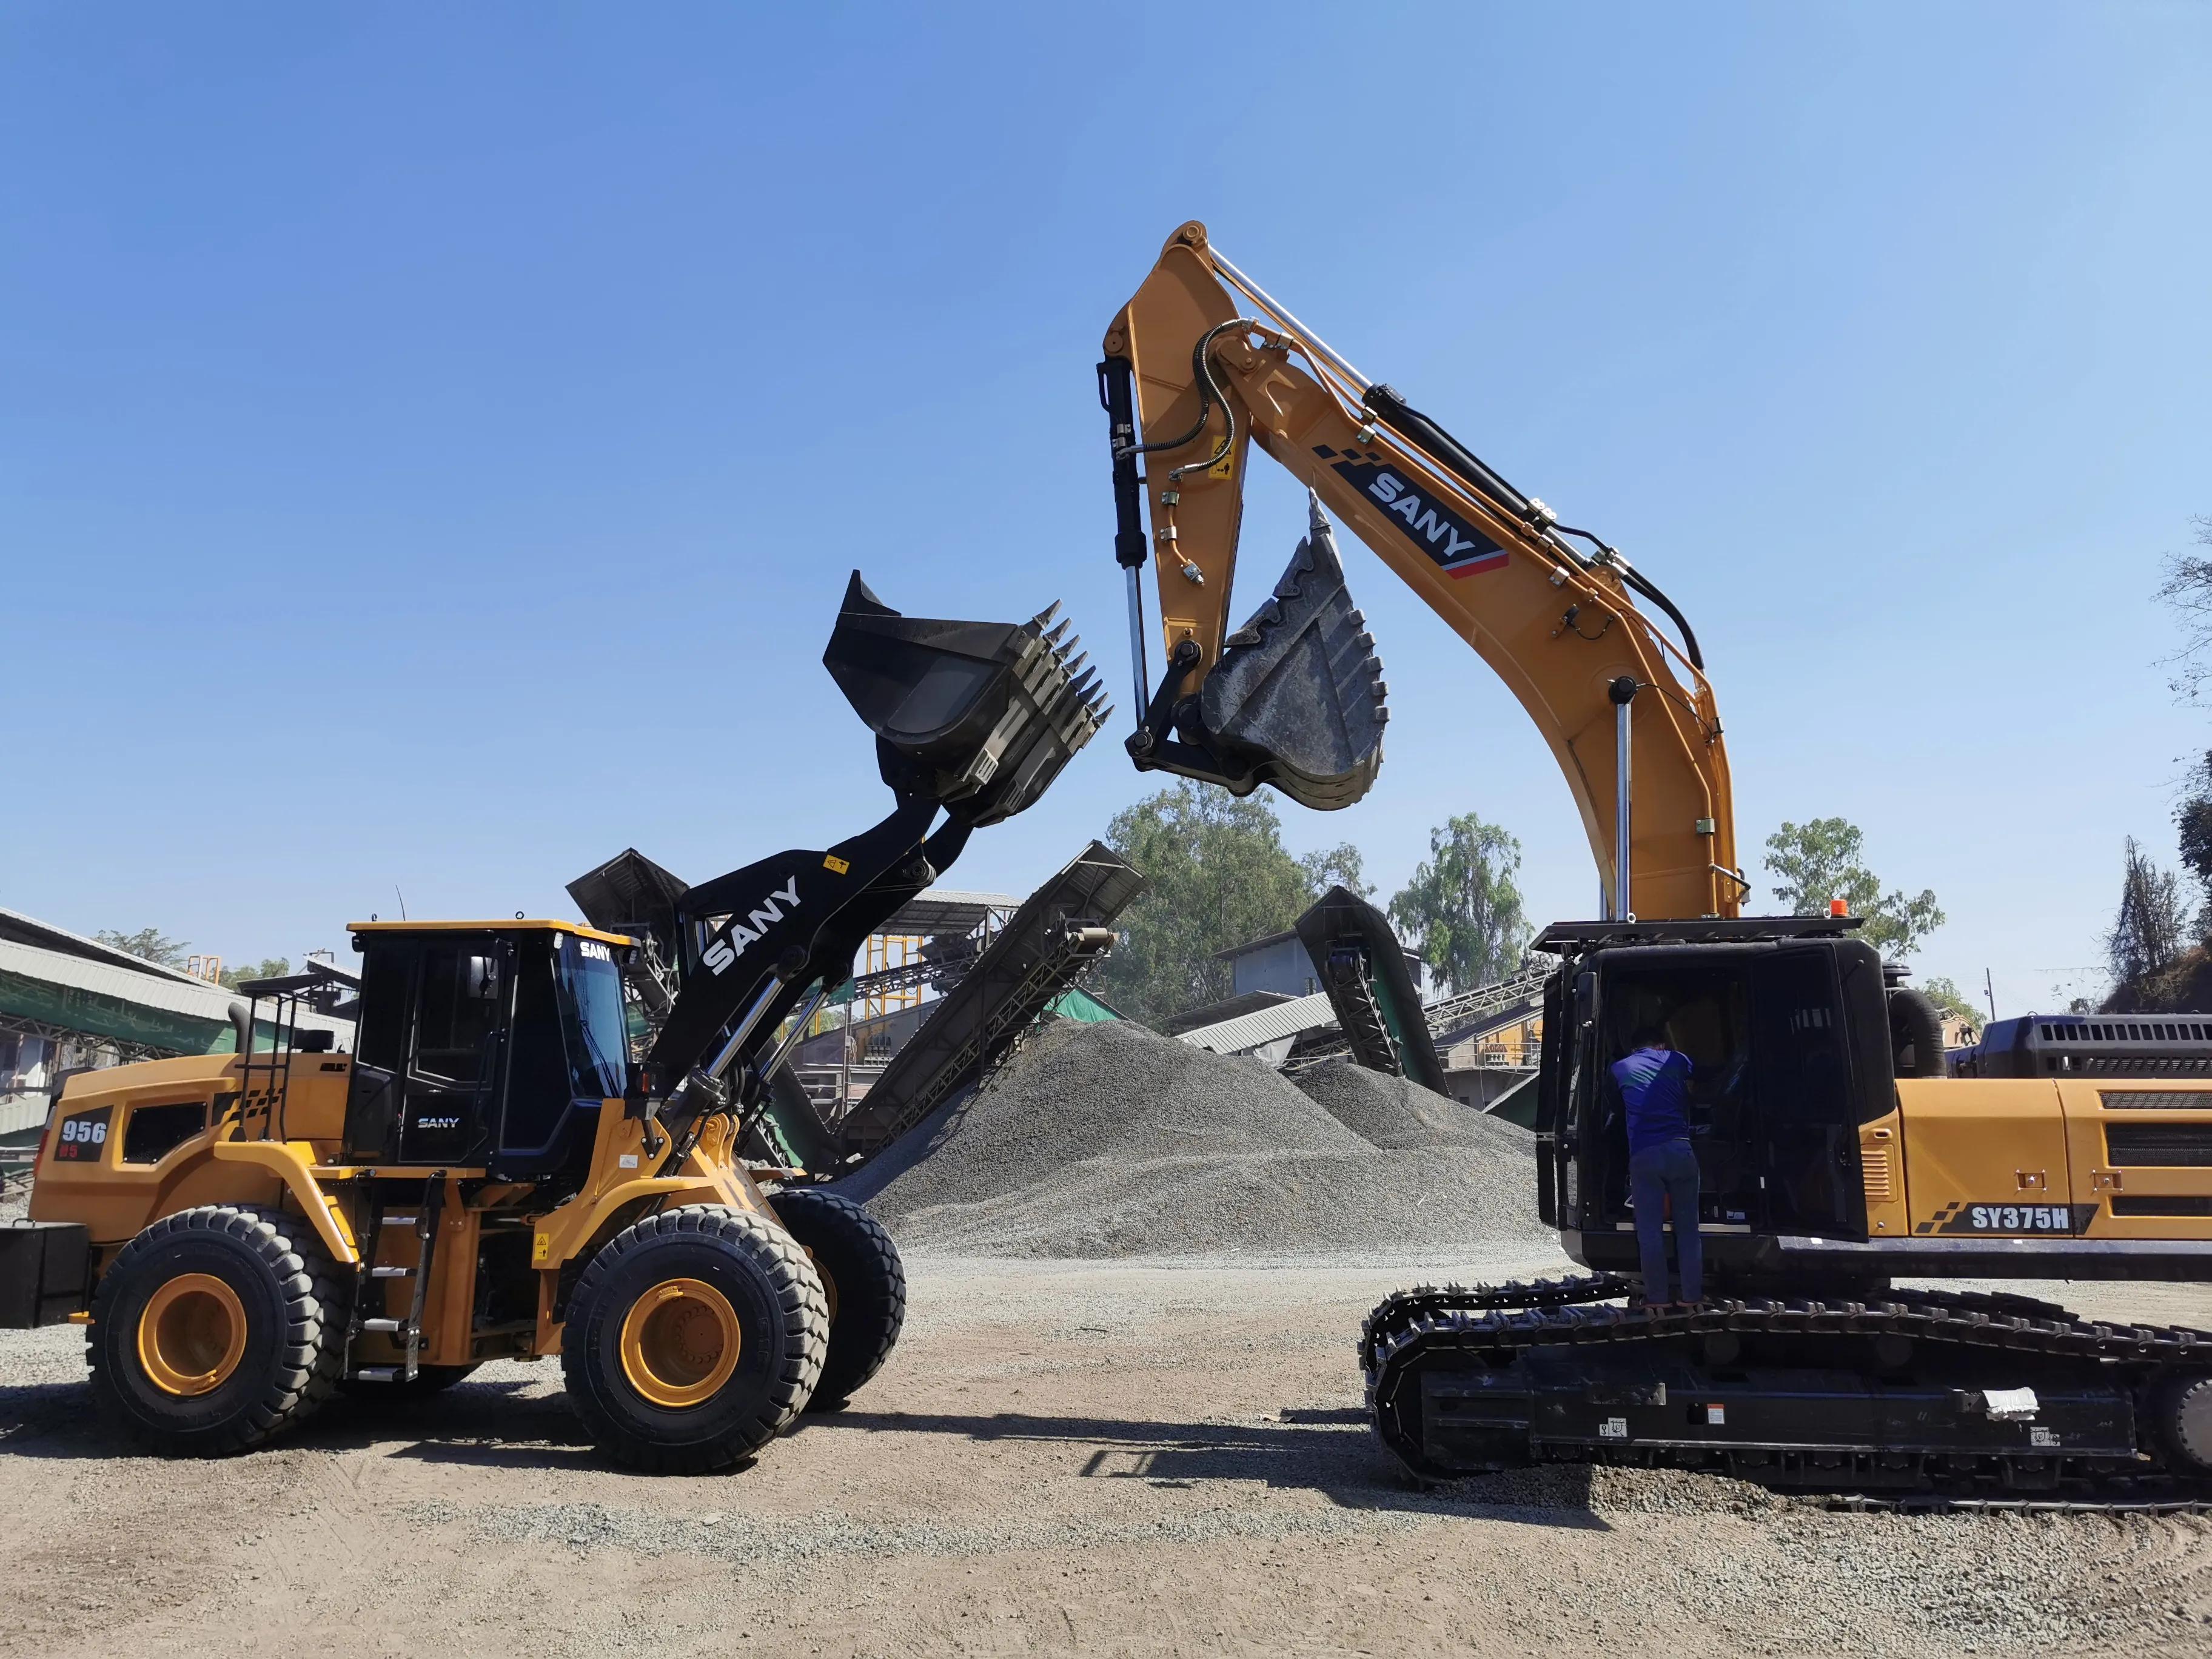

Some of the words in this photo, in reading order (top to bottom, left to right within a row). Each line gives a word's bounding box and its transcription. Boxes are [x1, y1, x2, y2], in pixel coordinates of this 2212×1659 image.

[1368, 472, 1476, 557] SANY
[703, 874, 802, 976] SANY
[580, 941, 610, 962] SANY
[62, 1120, 107, 1144] 956
[418, 1118, 460, 1128] SANY
[1971, 1207, 2070, 1229] SY375H
